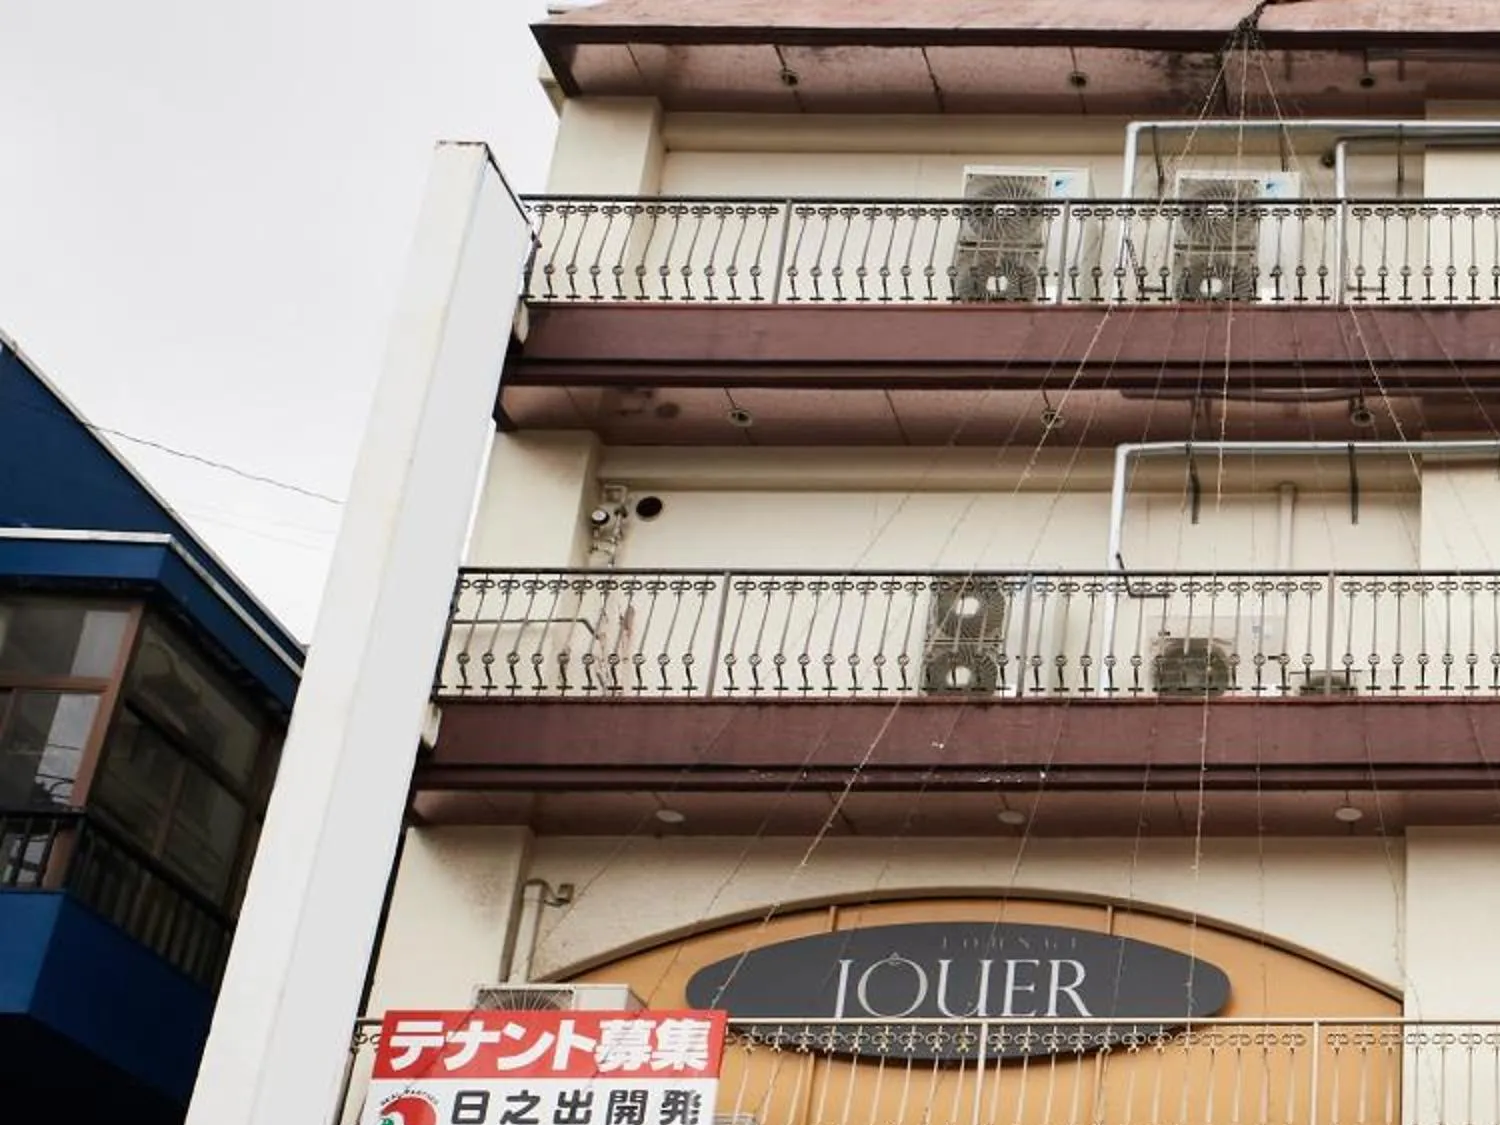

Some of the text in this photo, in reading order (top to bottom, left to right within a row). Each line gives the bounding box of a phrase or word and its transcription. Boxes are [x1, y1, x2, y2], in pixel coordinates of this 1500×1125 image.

[389, 1018, 711, 1073] テナント募集
